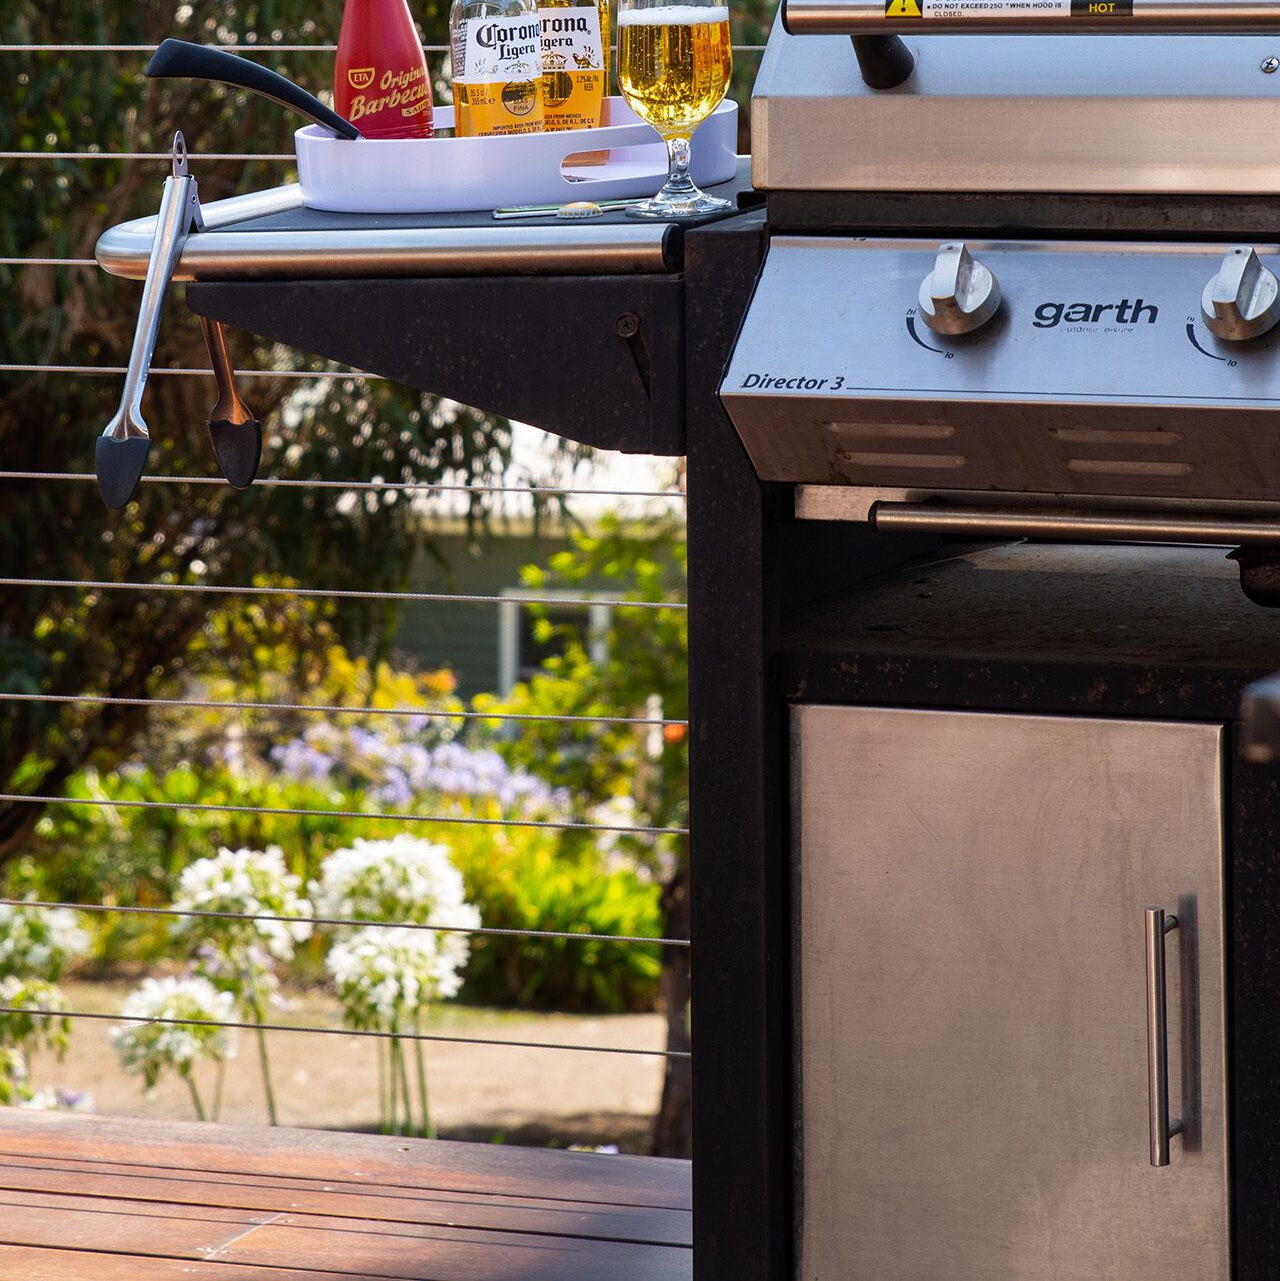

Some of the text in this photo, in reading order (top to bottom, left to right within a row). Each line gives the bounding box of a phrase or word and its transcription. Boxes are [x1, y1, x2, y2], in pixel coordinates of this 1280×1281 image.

[1089, 3, 1115, 13] HOT
[540, 18, 588, 33] rona
[540, 36, 574, 51] igera
[498, 44, 535, 60] Ligera
[353, 73, 368, 82] ETA
[1032, 299, 1159, 328] garth
[740, 373, 845, 390] Director 3
